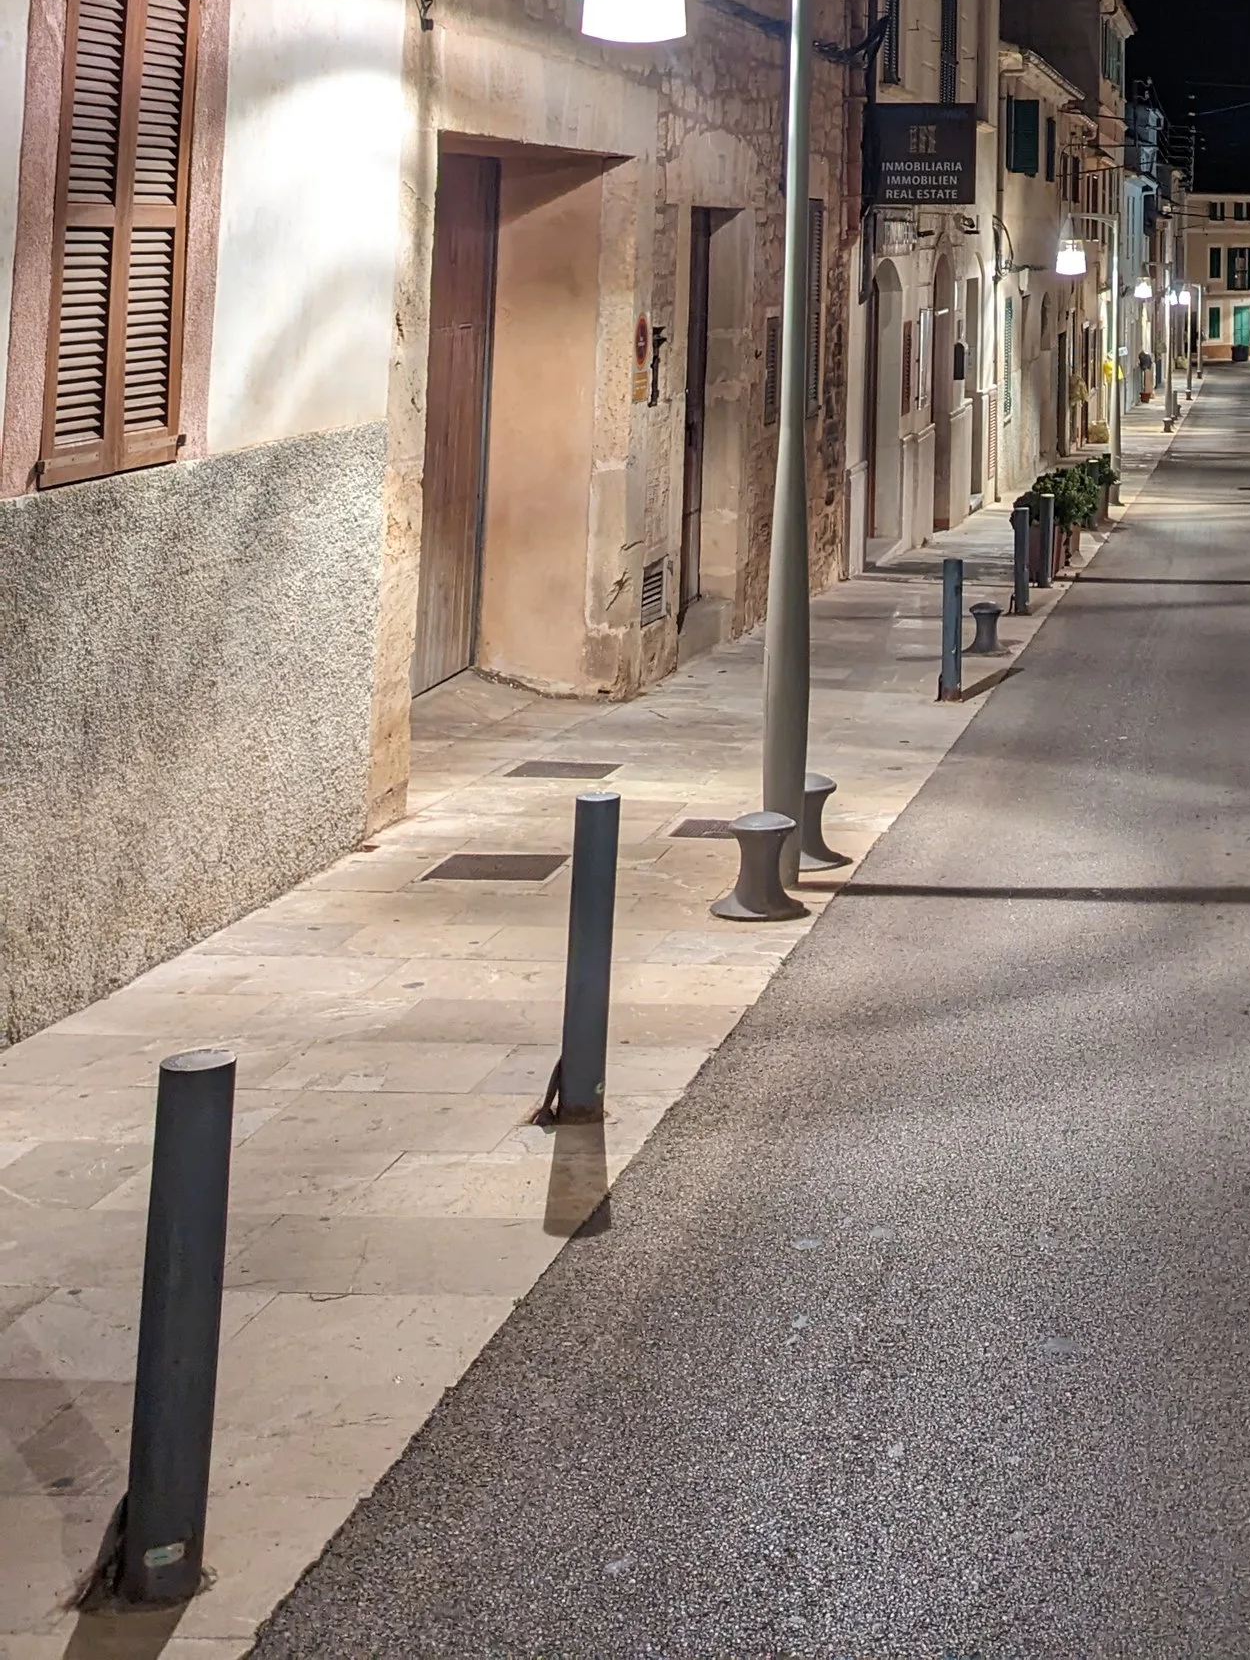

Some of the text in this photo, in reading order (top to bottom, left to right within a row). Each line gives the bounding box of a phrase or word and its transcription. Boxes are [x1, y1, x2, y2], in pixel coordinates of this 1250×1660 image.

[881, 162, 963, 171] INMOBILIARIA
[886, 176, 958, 185] IMMOBILIEN
[886, 189, 958, 199] REAL ESTATE
